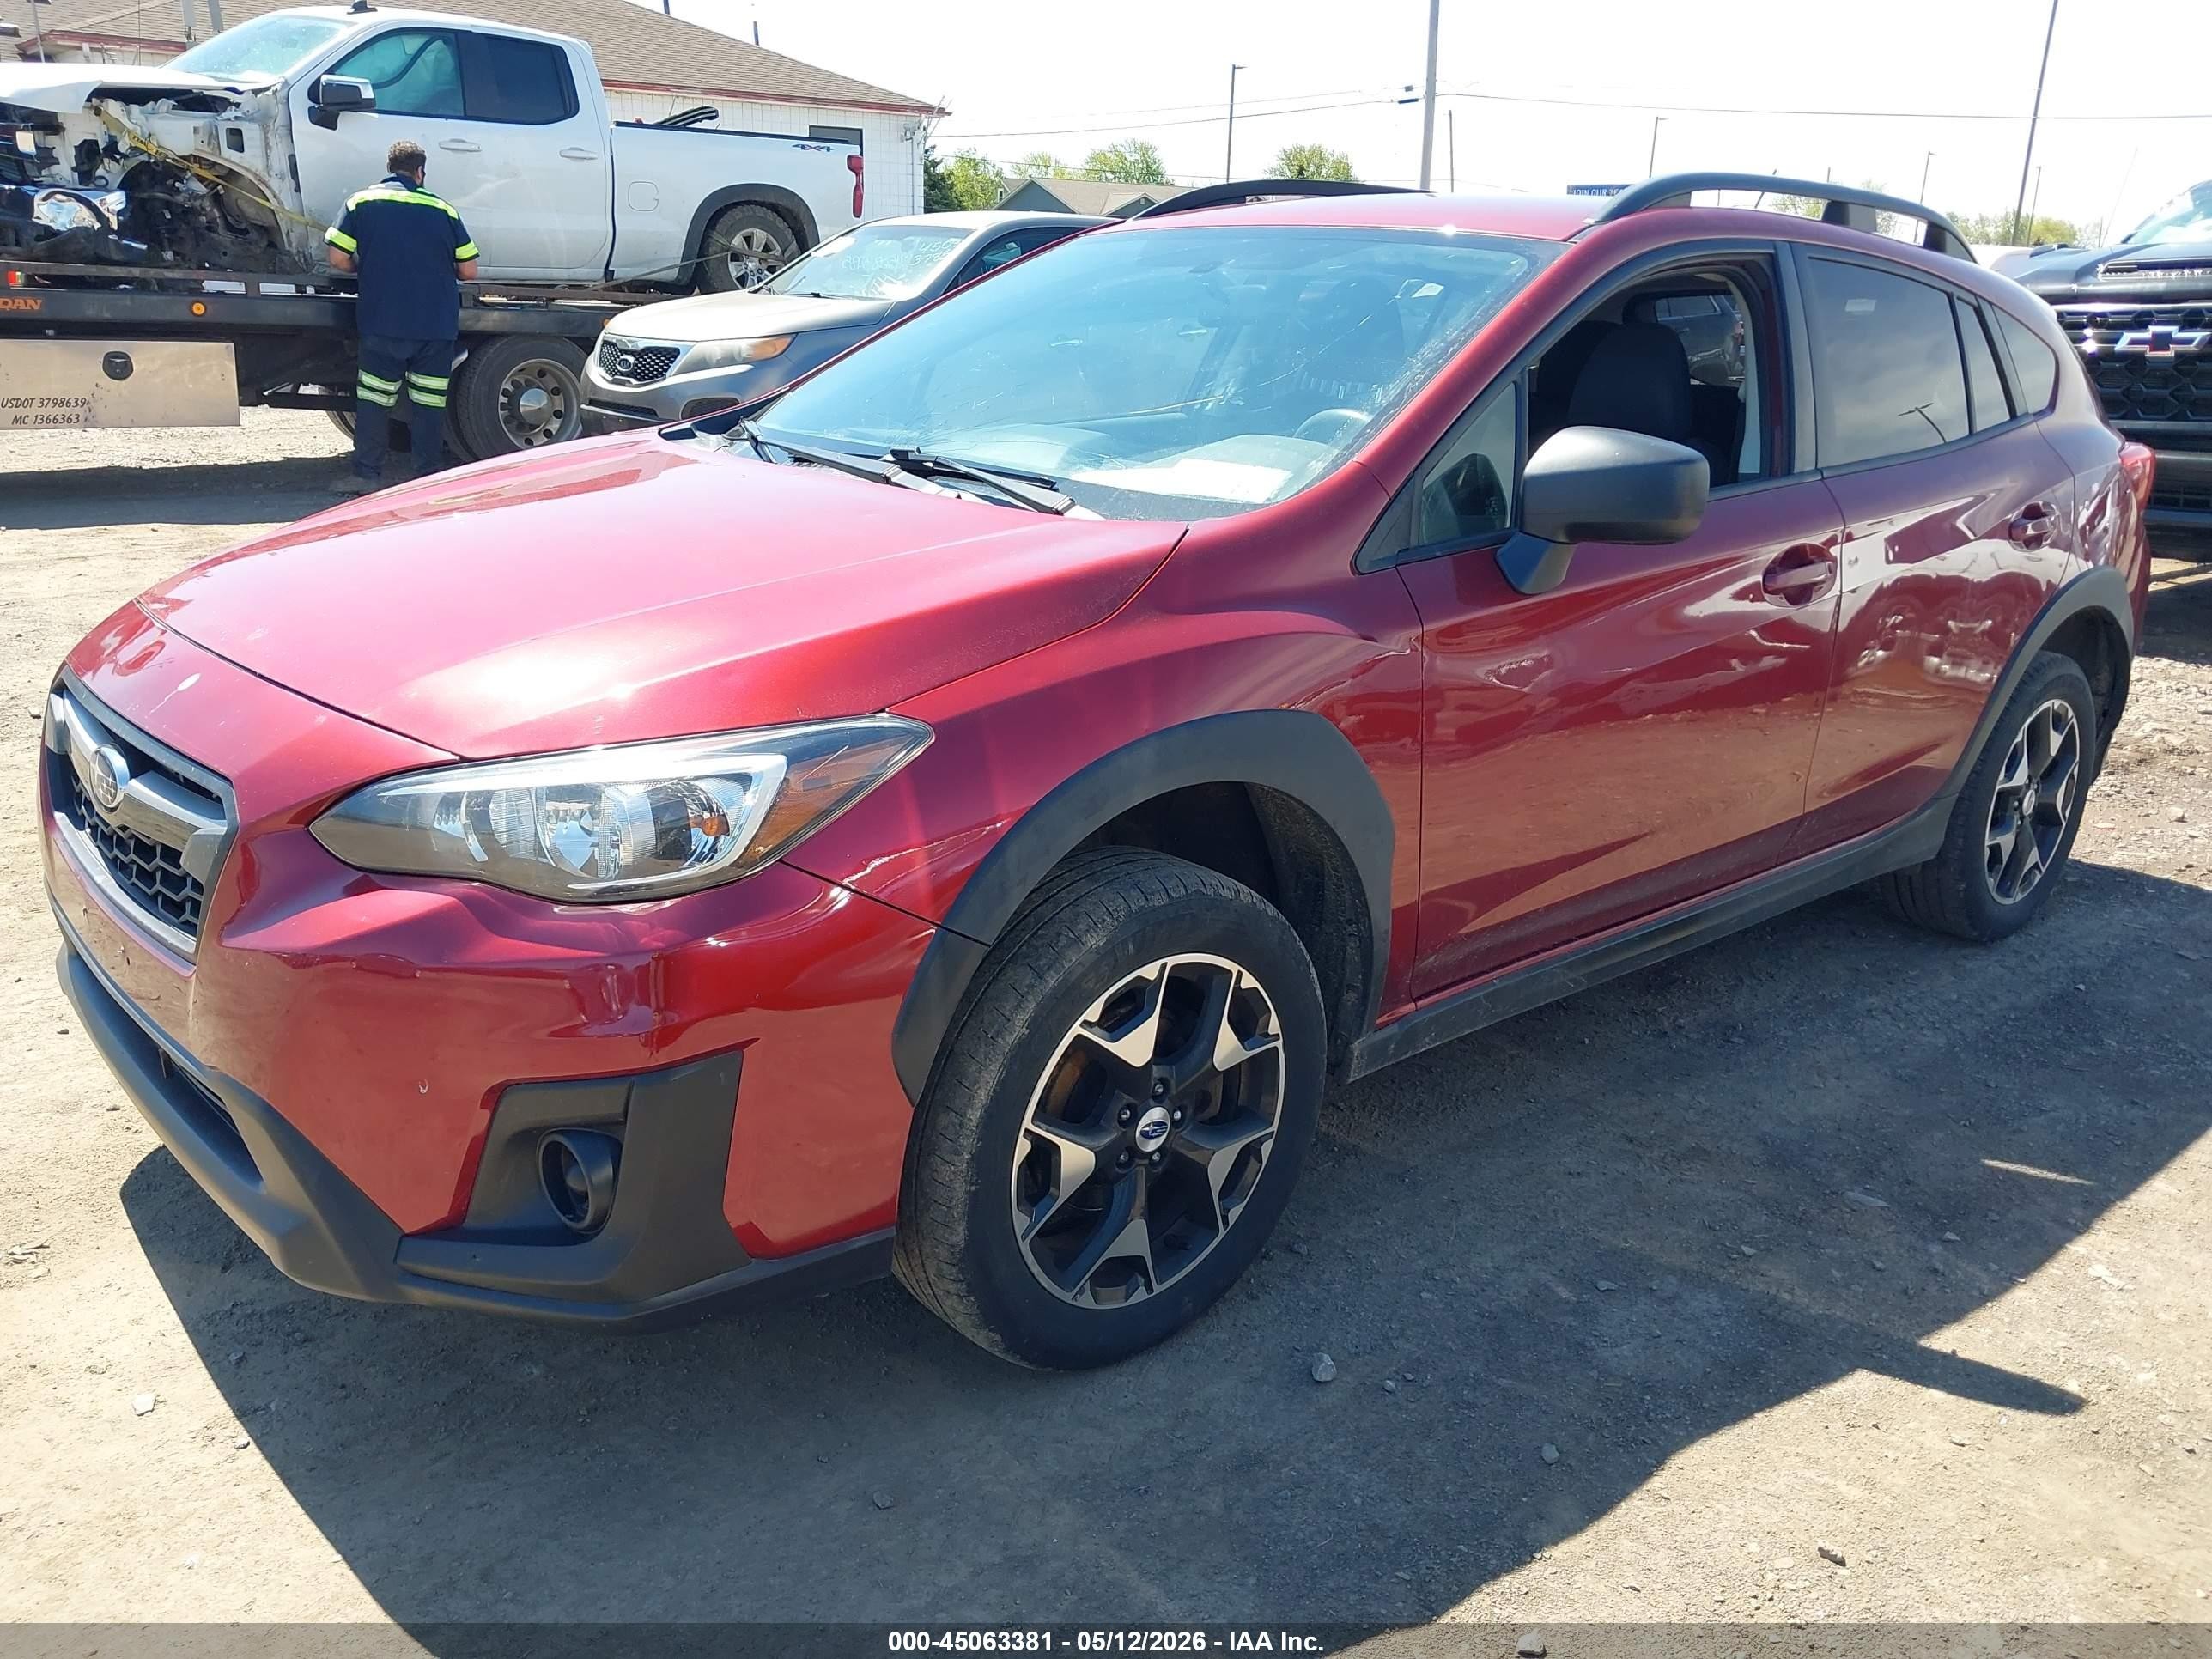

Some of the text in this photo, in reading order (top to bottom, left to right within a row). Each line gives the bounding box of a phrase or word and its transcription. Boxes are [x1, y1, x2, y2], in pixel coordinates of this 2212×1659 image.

[1, 398, 86, 409] USDOT 3798639
[11, 414, 80, 425] MC 1366363
